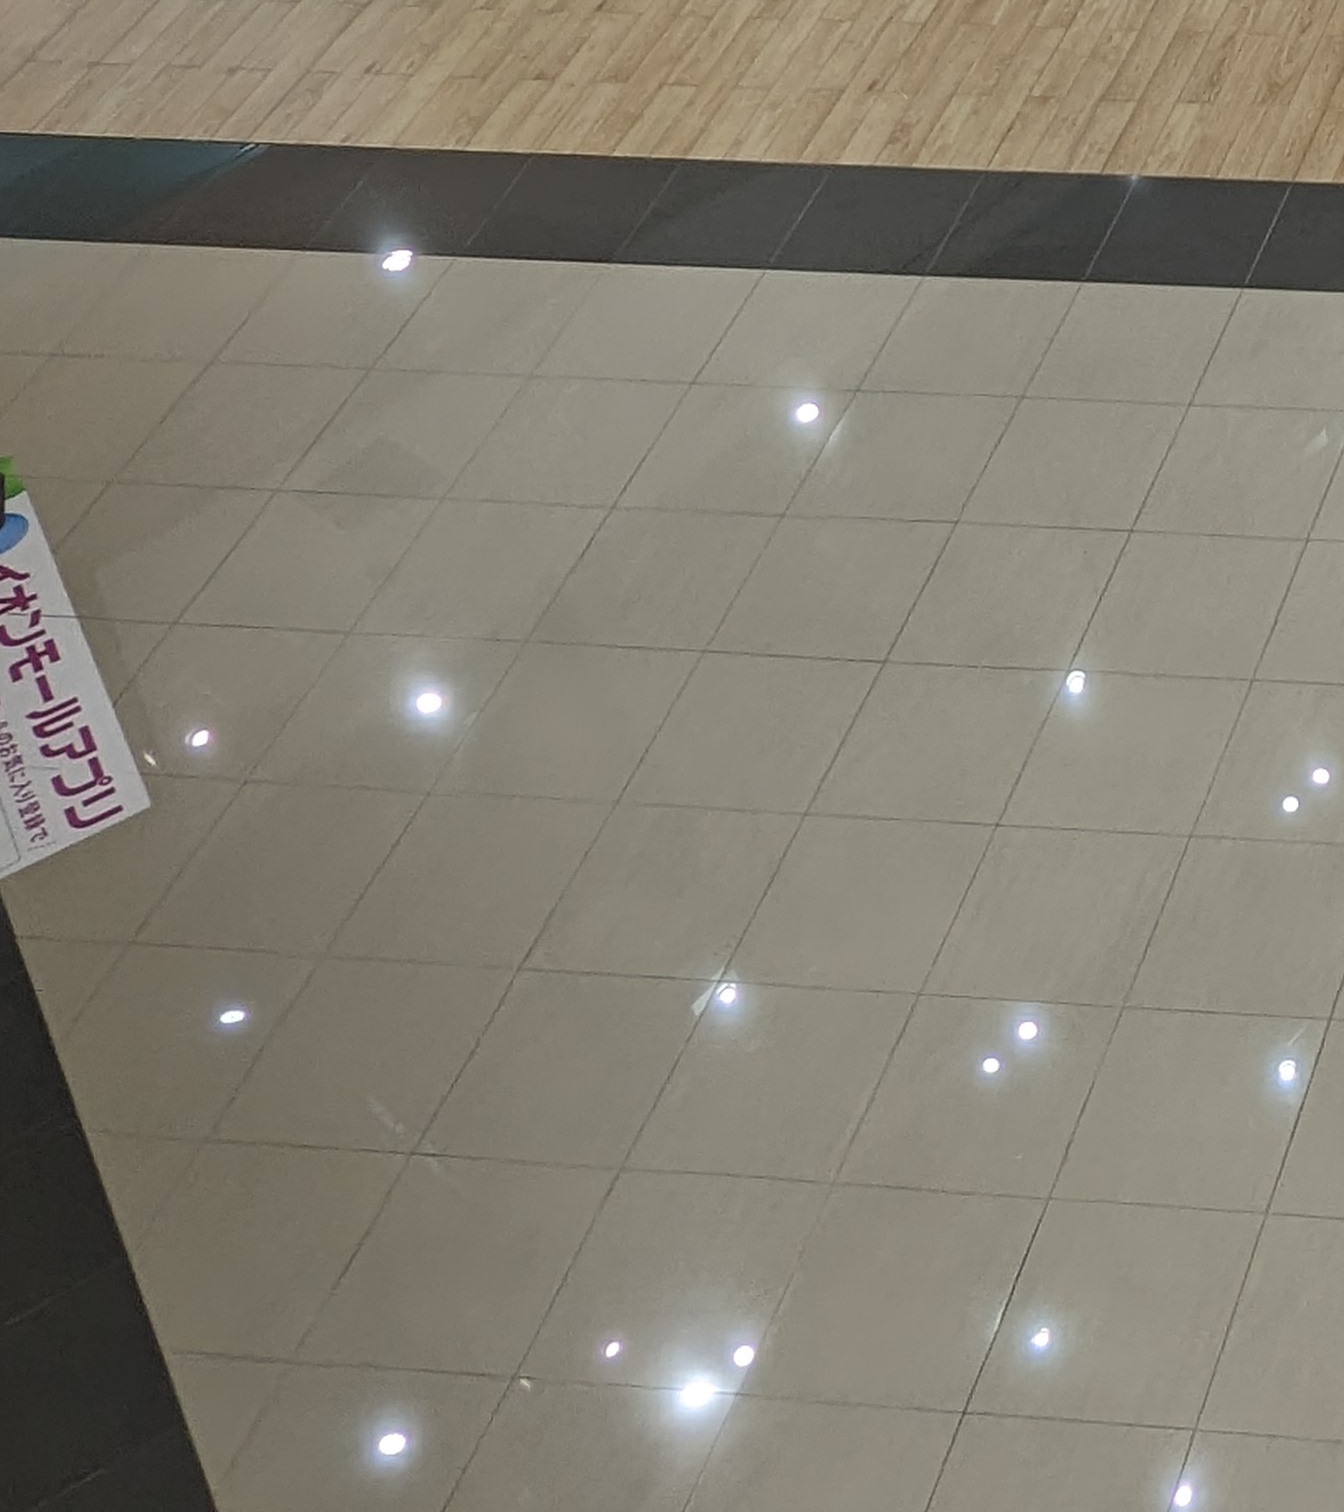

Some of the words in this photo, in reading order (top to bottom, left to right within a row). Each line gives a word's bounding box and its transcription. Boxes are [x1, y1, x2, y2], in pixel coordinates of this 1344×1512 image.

[0, 564, 124, 829] イオンモールアプリ
